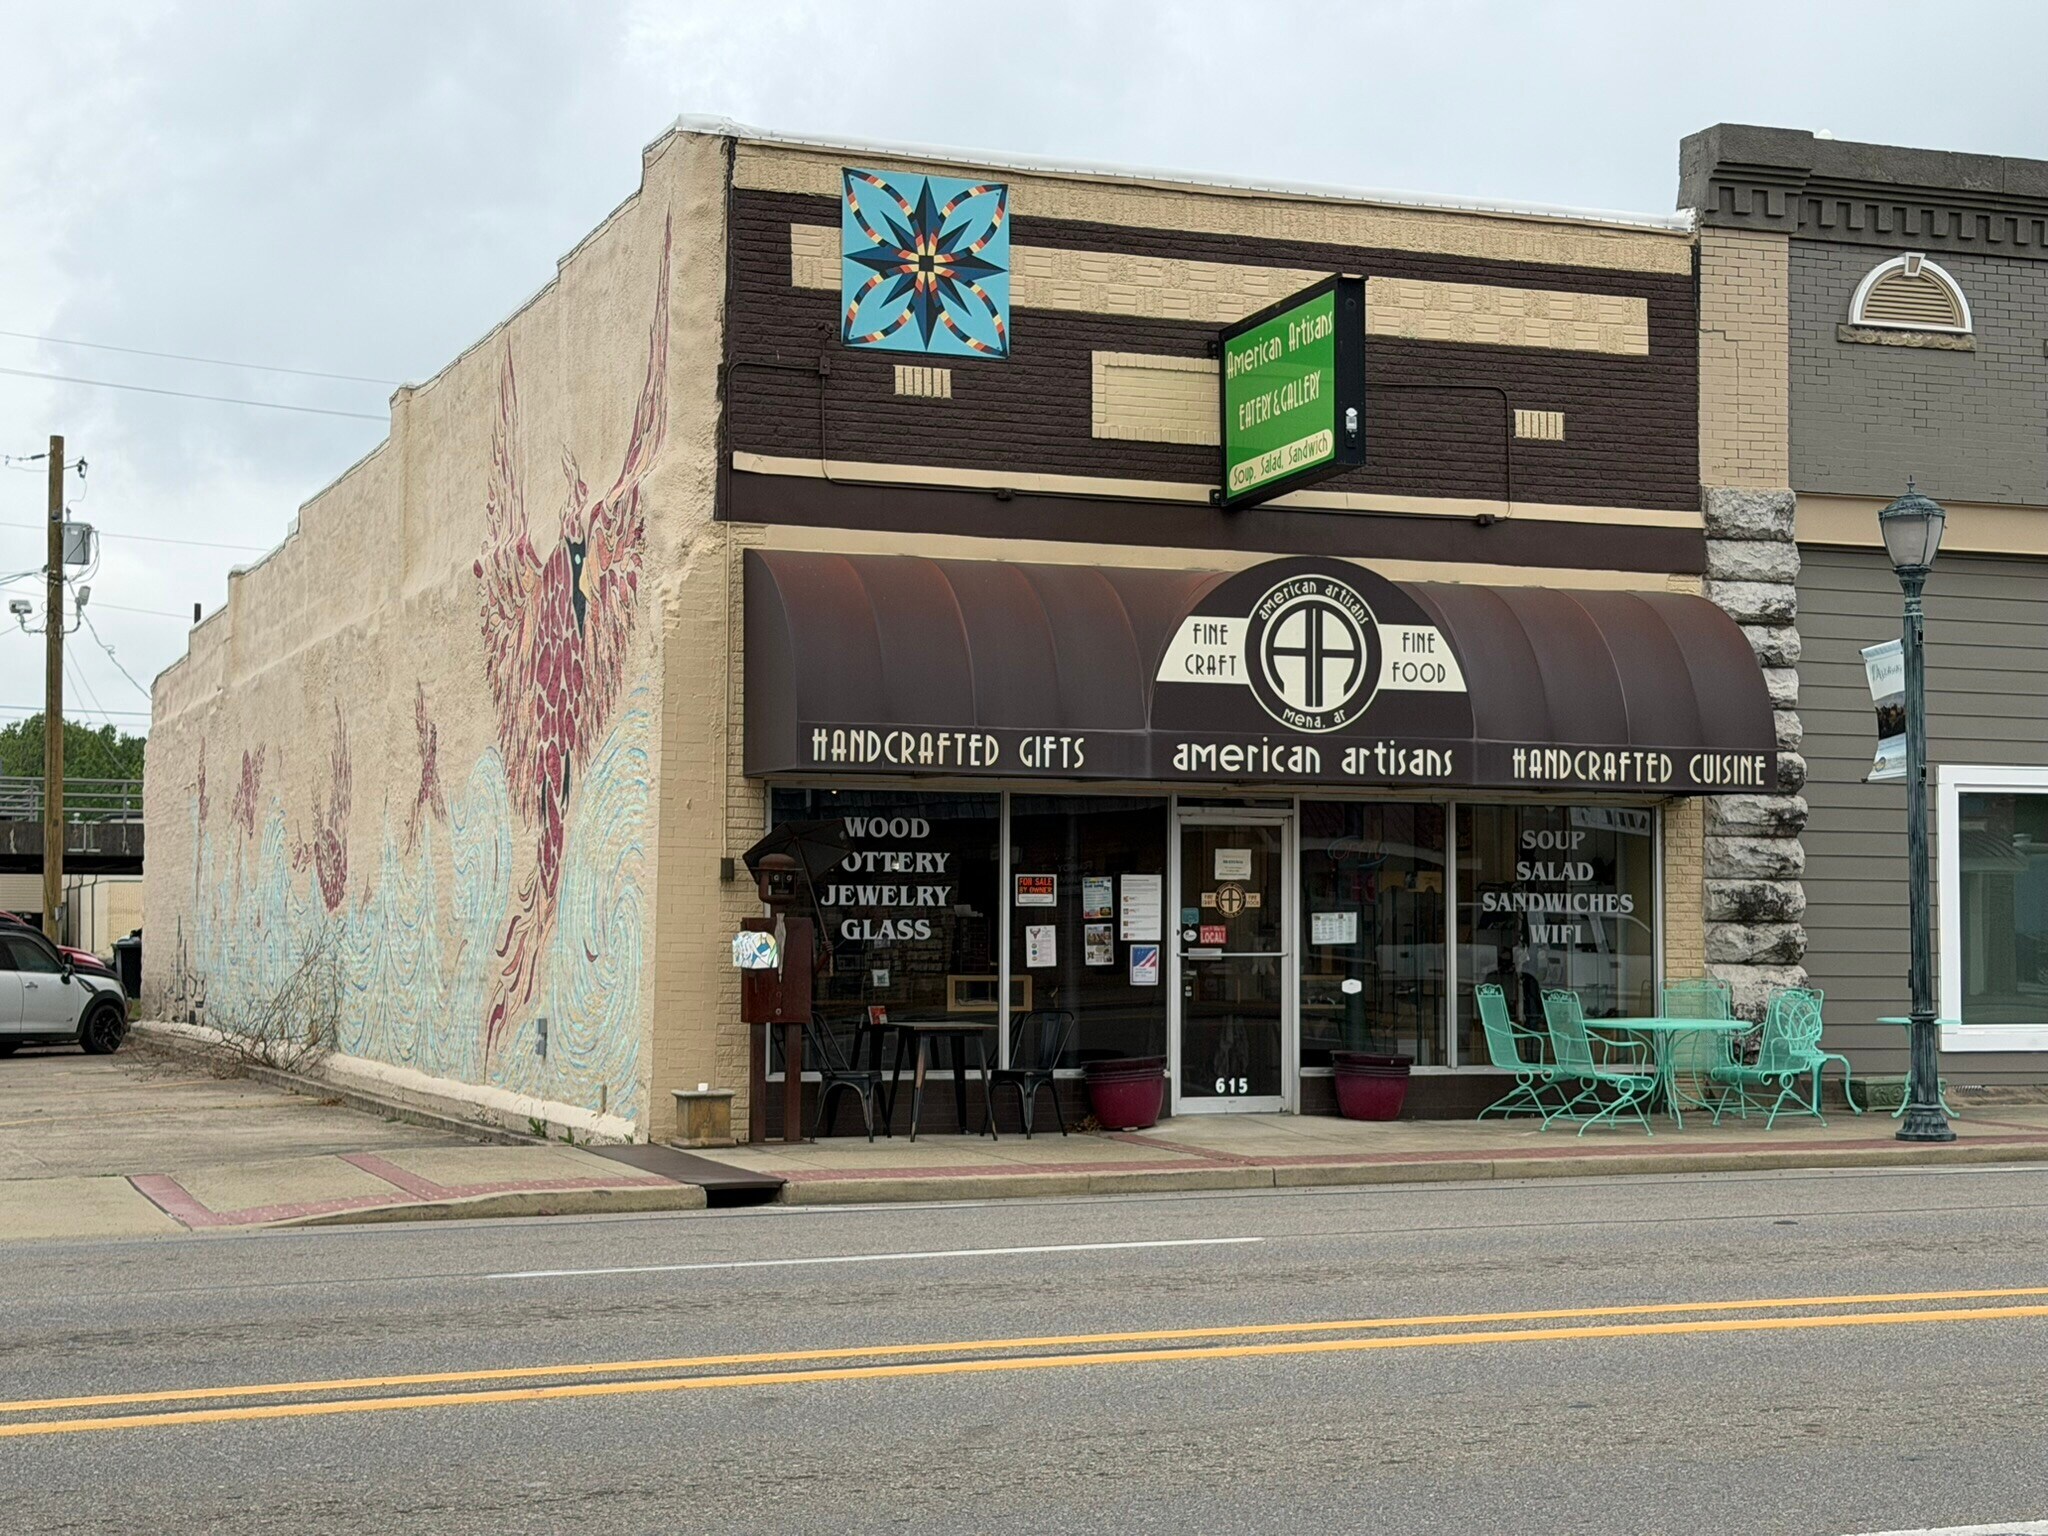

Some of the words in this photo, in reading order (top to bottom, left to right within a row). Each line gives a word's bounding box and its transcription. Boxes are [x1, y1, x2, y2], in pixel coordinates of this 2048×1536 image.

[1227, 337, 1283, 379] American
[1288, 311, 1333, 351] Artisans
[1239, 391, 1272, 431] EATERY
[1281, 369, 1321, 412] GALLERY
[1288, 433, 1328, 465] Sandwich
[1258, 581, 1317, 620] american
[1324, 584, 1369, 625] artisans
[1193, 623, 1228, 646] FINE
[1402, 632, 1436, 654] FINE
[1184, 653, 1237, 677] CRAFT
[1391, 662, 1446, 684] FOOD
[1333, 709, 1347, 724] ar
[812, 728, 999, 767] HANDCRAFTED
[1019, 735, 1085, 769] GIFTS
[1172, 736, 1321, 774] american
[1341, 739, 1453, 777] artisans
[1512, 748, 1673, 784] HANDCRAFTED
[1689, 753, 1767, 786] CUISINE
[843, 816, 931, 839] WOOD
[1522, 830, 1586, 850] SOUP
[841, 851, 951, 873] OTTERY
[1516, 861, 1594, 881] SALAD
[1019, 877, 1033, 886] FOR
[1034, 877, 1053, 886] SALE
[1029, 886, 1053, 894] OWNER
[821, 884, 952, 907] JEWELRY
[1482, 892, 1635, 913] SANDWICHES
[841, 919, 932, 941] GLASS
[1530, 924, 1582, 944] WIFI
[1215, 1077, 1248, 1094] 615
